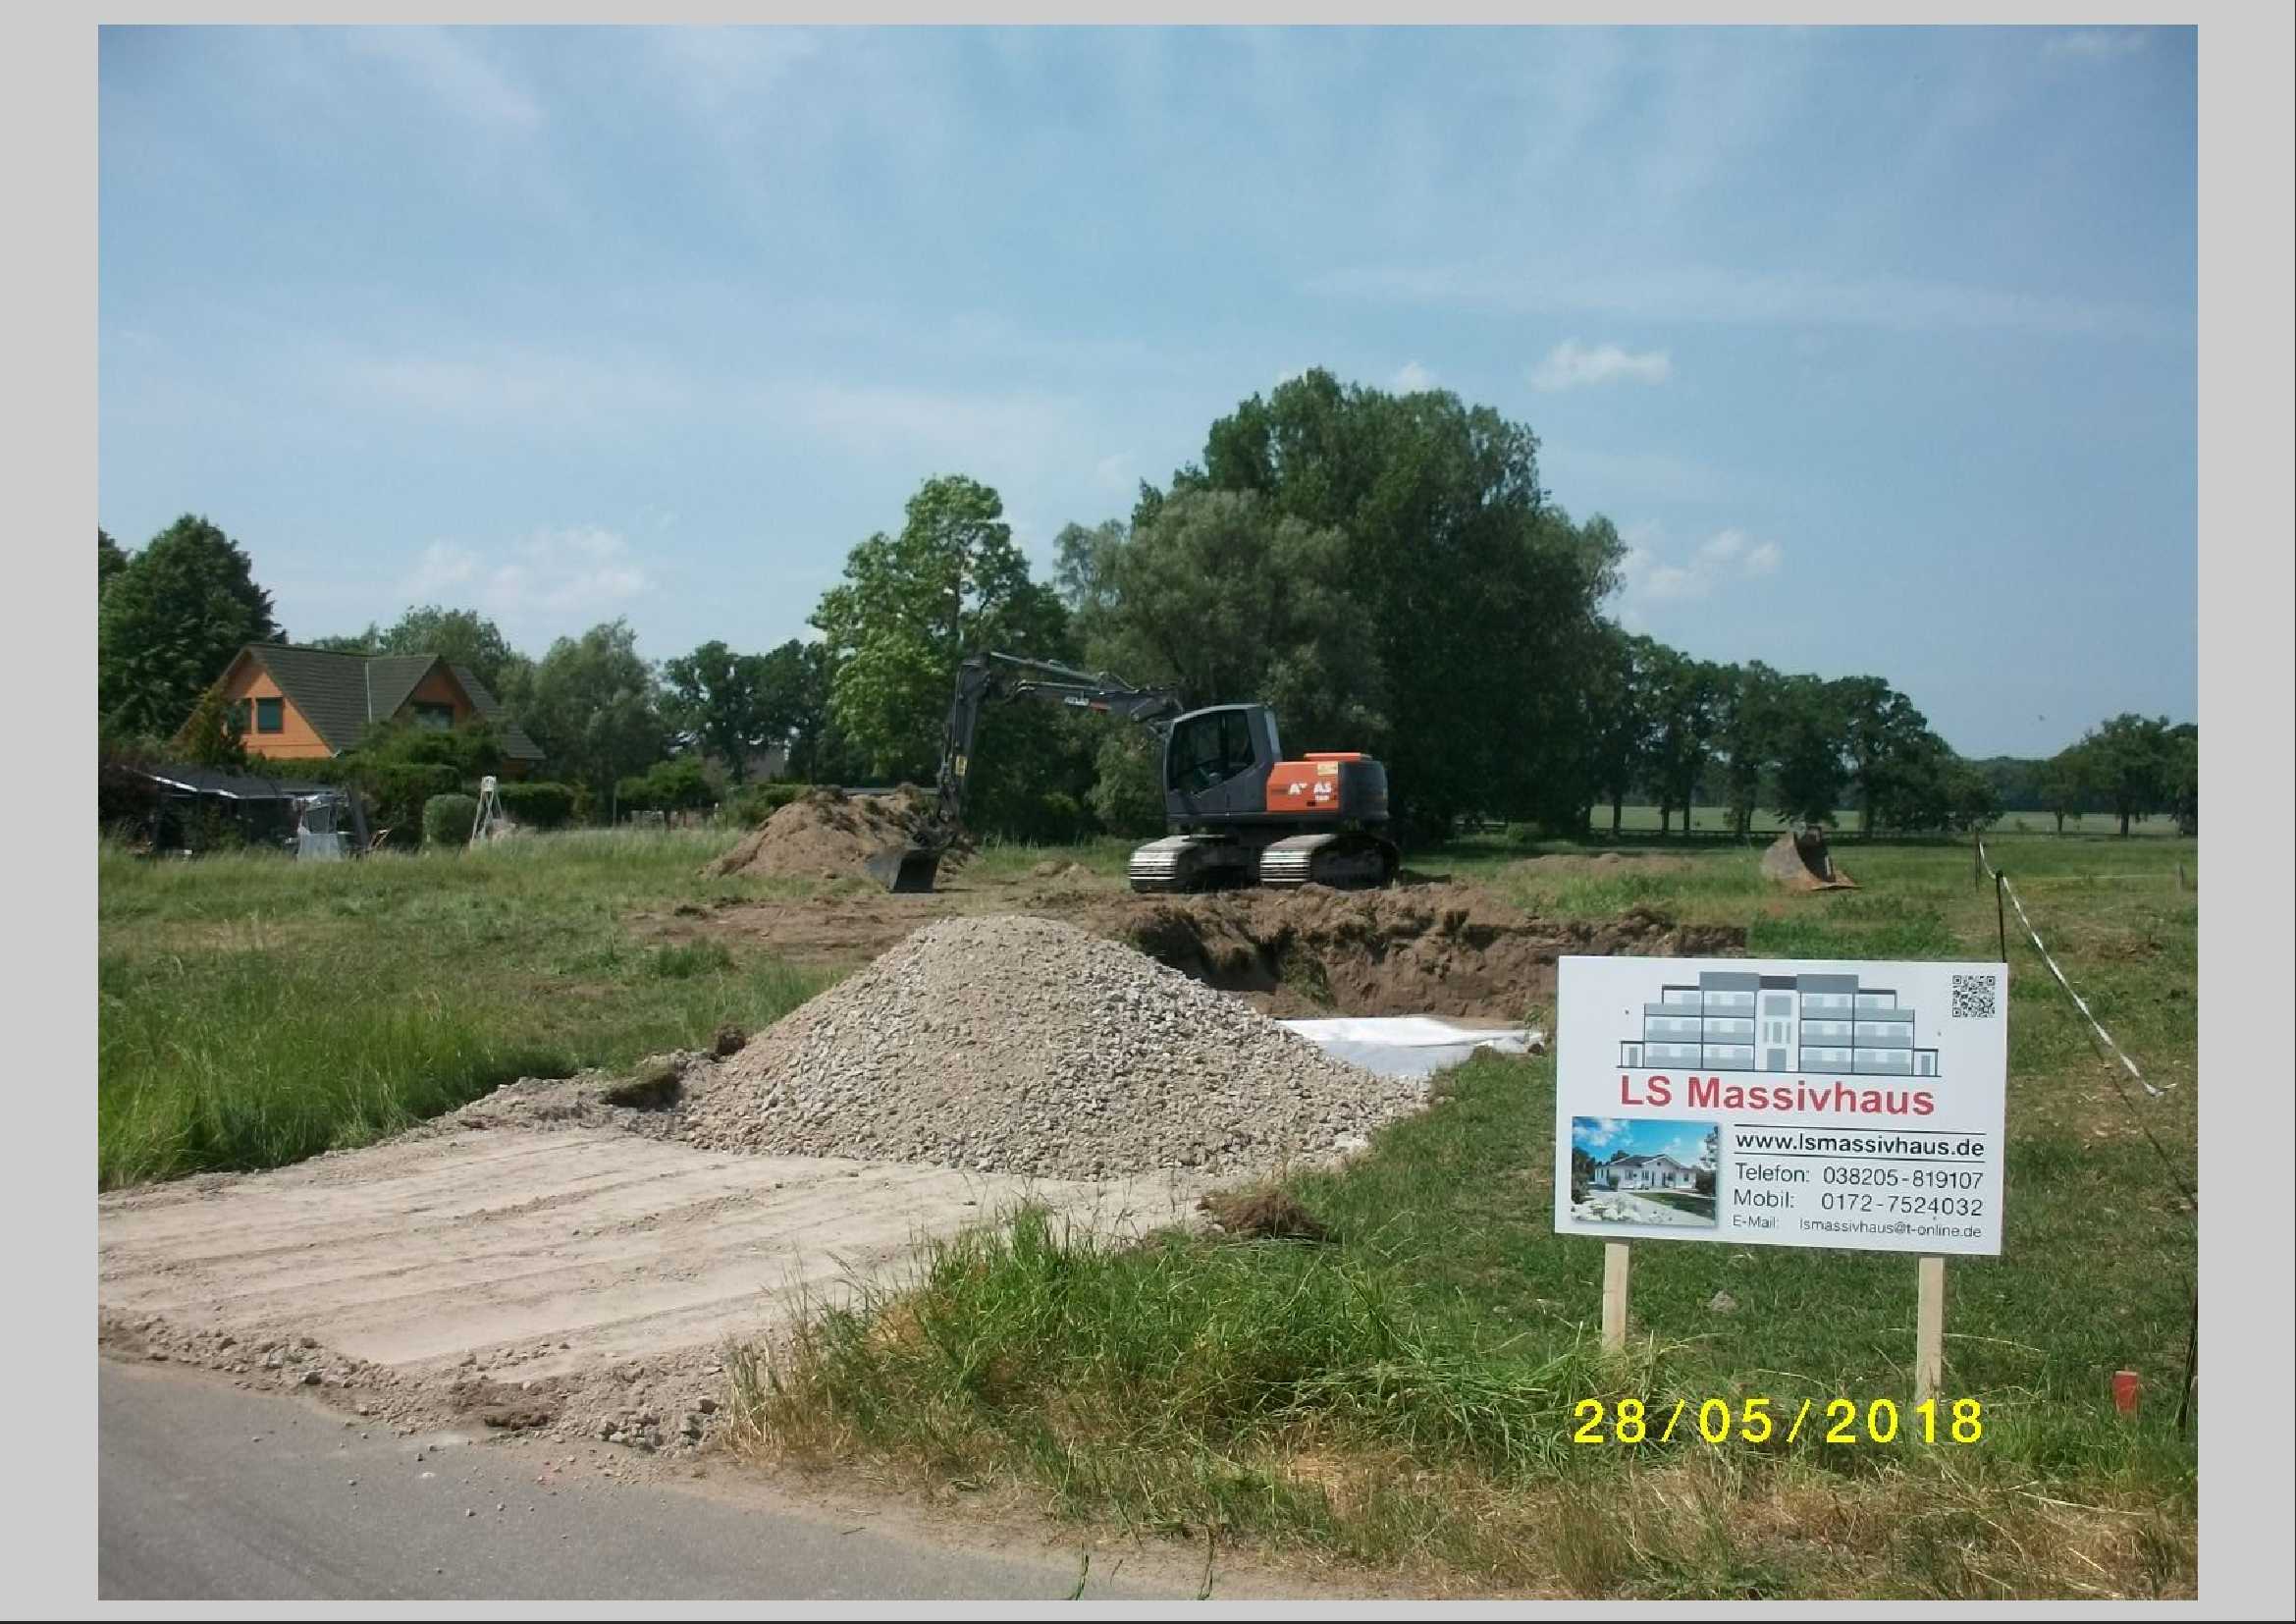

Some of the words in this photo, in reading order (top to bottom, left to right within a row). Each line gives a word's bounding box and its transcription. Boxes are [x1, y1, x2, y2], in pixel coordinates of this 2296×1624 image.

[1621, 1074, 1673, 1107] LS
[1686, 1076, 1936, 1116] Massivhaus
[1735, 1132, 1985, 1157] www.lsmassivhaus.de
[1735, 1163, 1810, 1184] Telefon:
[1823, 1165, 1984, 1190] 038205-819107
[1734, 1190, 1794, 1210] Mobil:
[1821, 1193, 1983, 1217] 0172-7524032
[1733, 1215, 1779, 1229] E-Mail:
